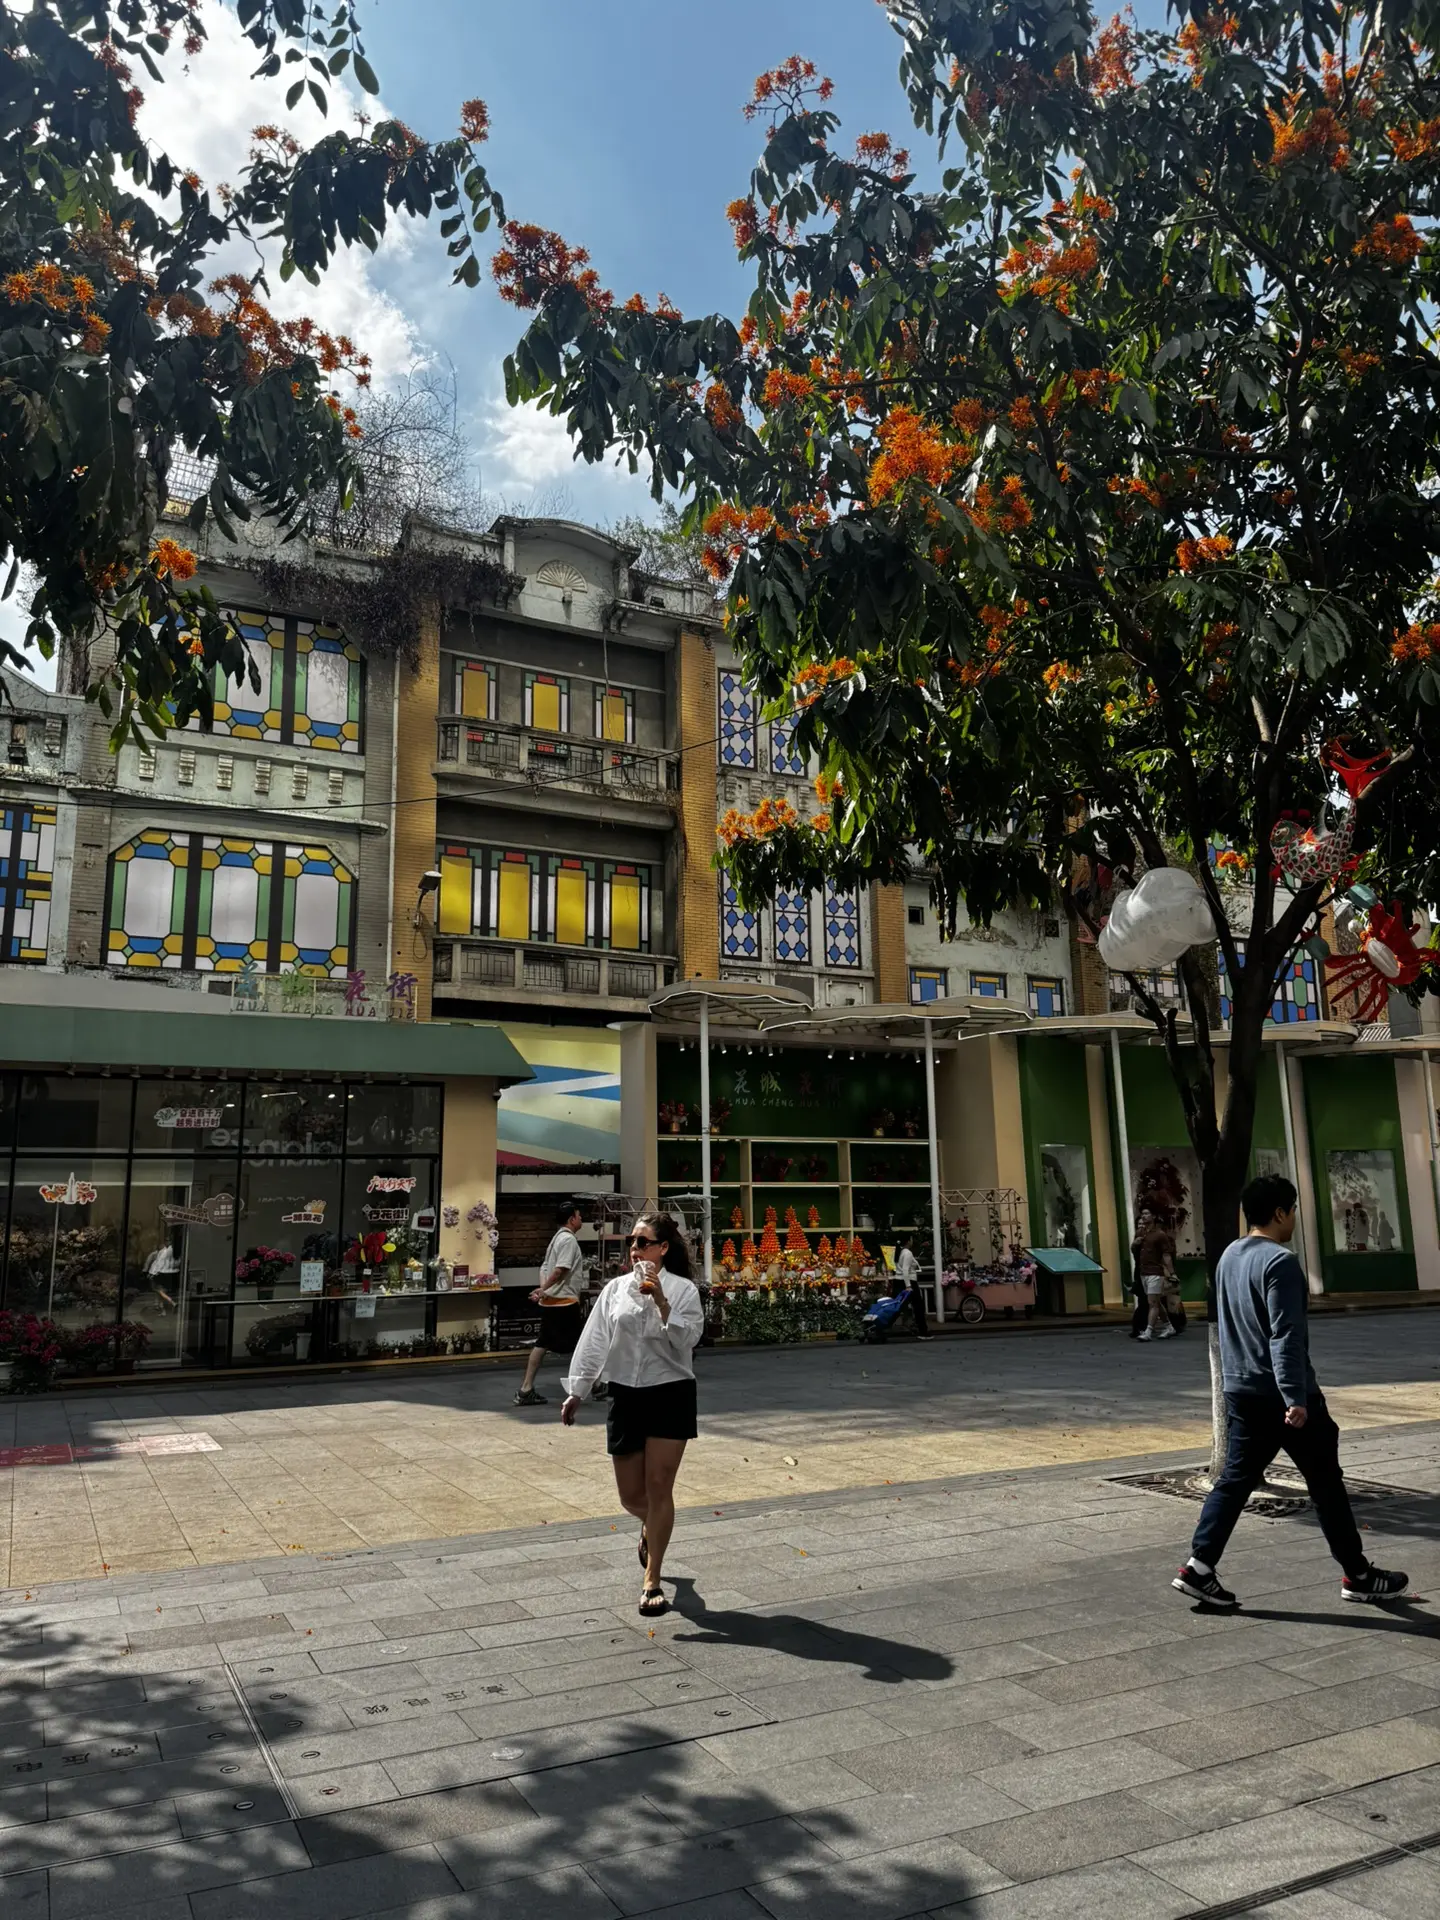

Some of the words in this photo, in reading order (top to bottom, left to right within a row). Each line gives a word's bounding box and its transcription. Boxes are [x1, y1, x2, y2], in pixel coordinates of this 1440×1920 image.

[236, 999, 269, 1012] HUA
[281, 1001, 334, 1015] CHENG
[345, 1002, 376, 1017] HUA
